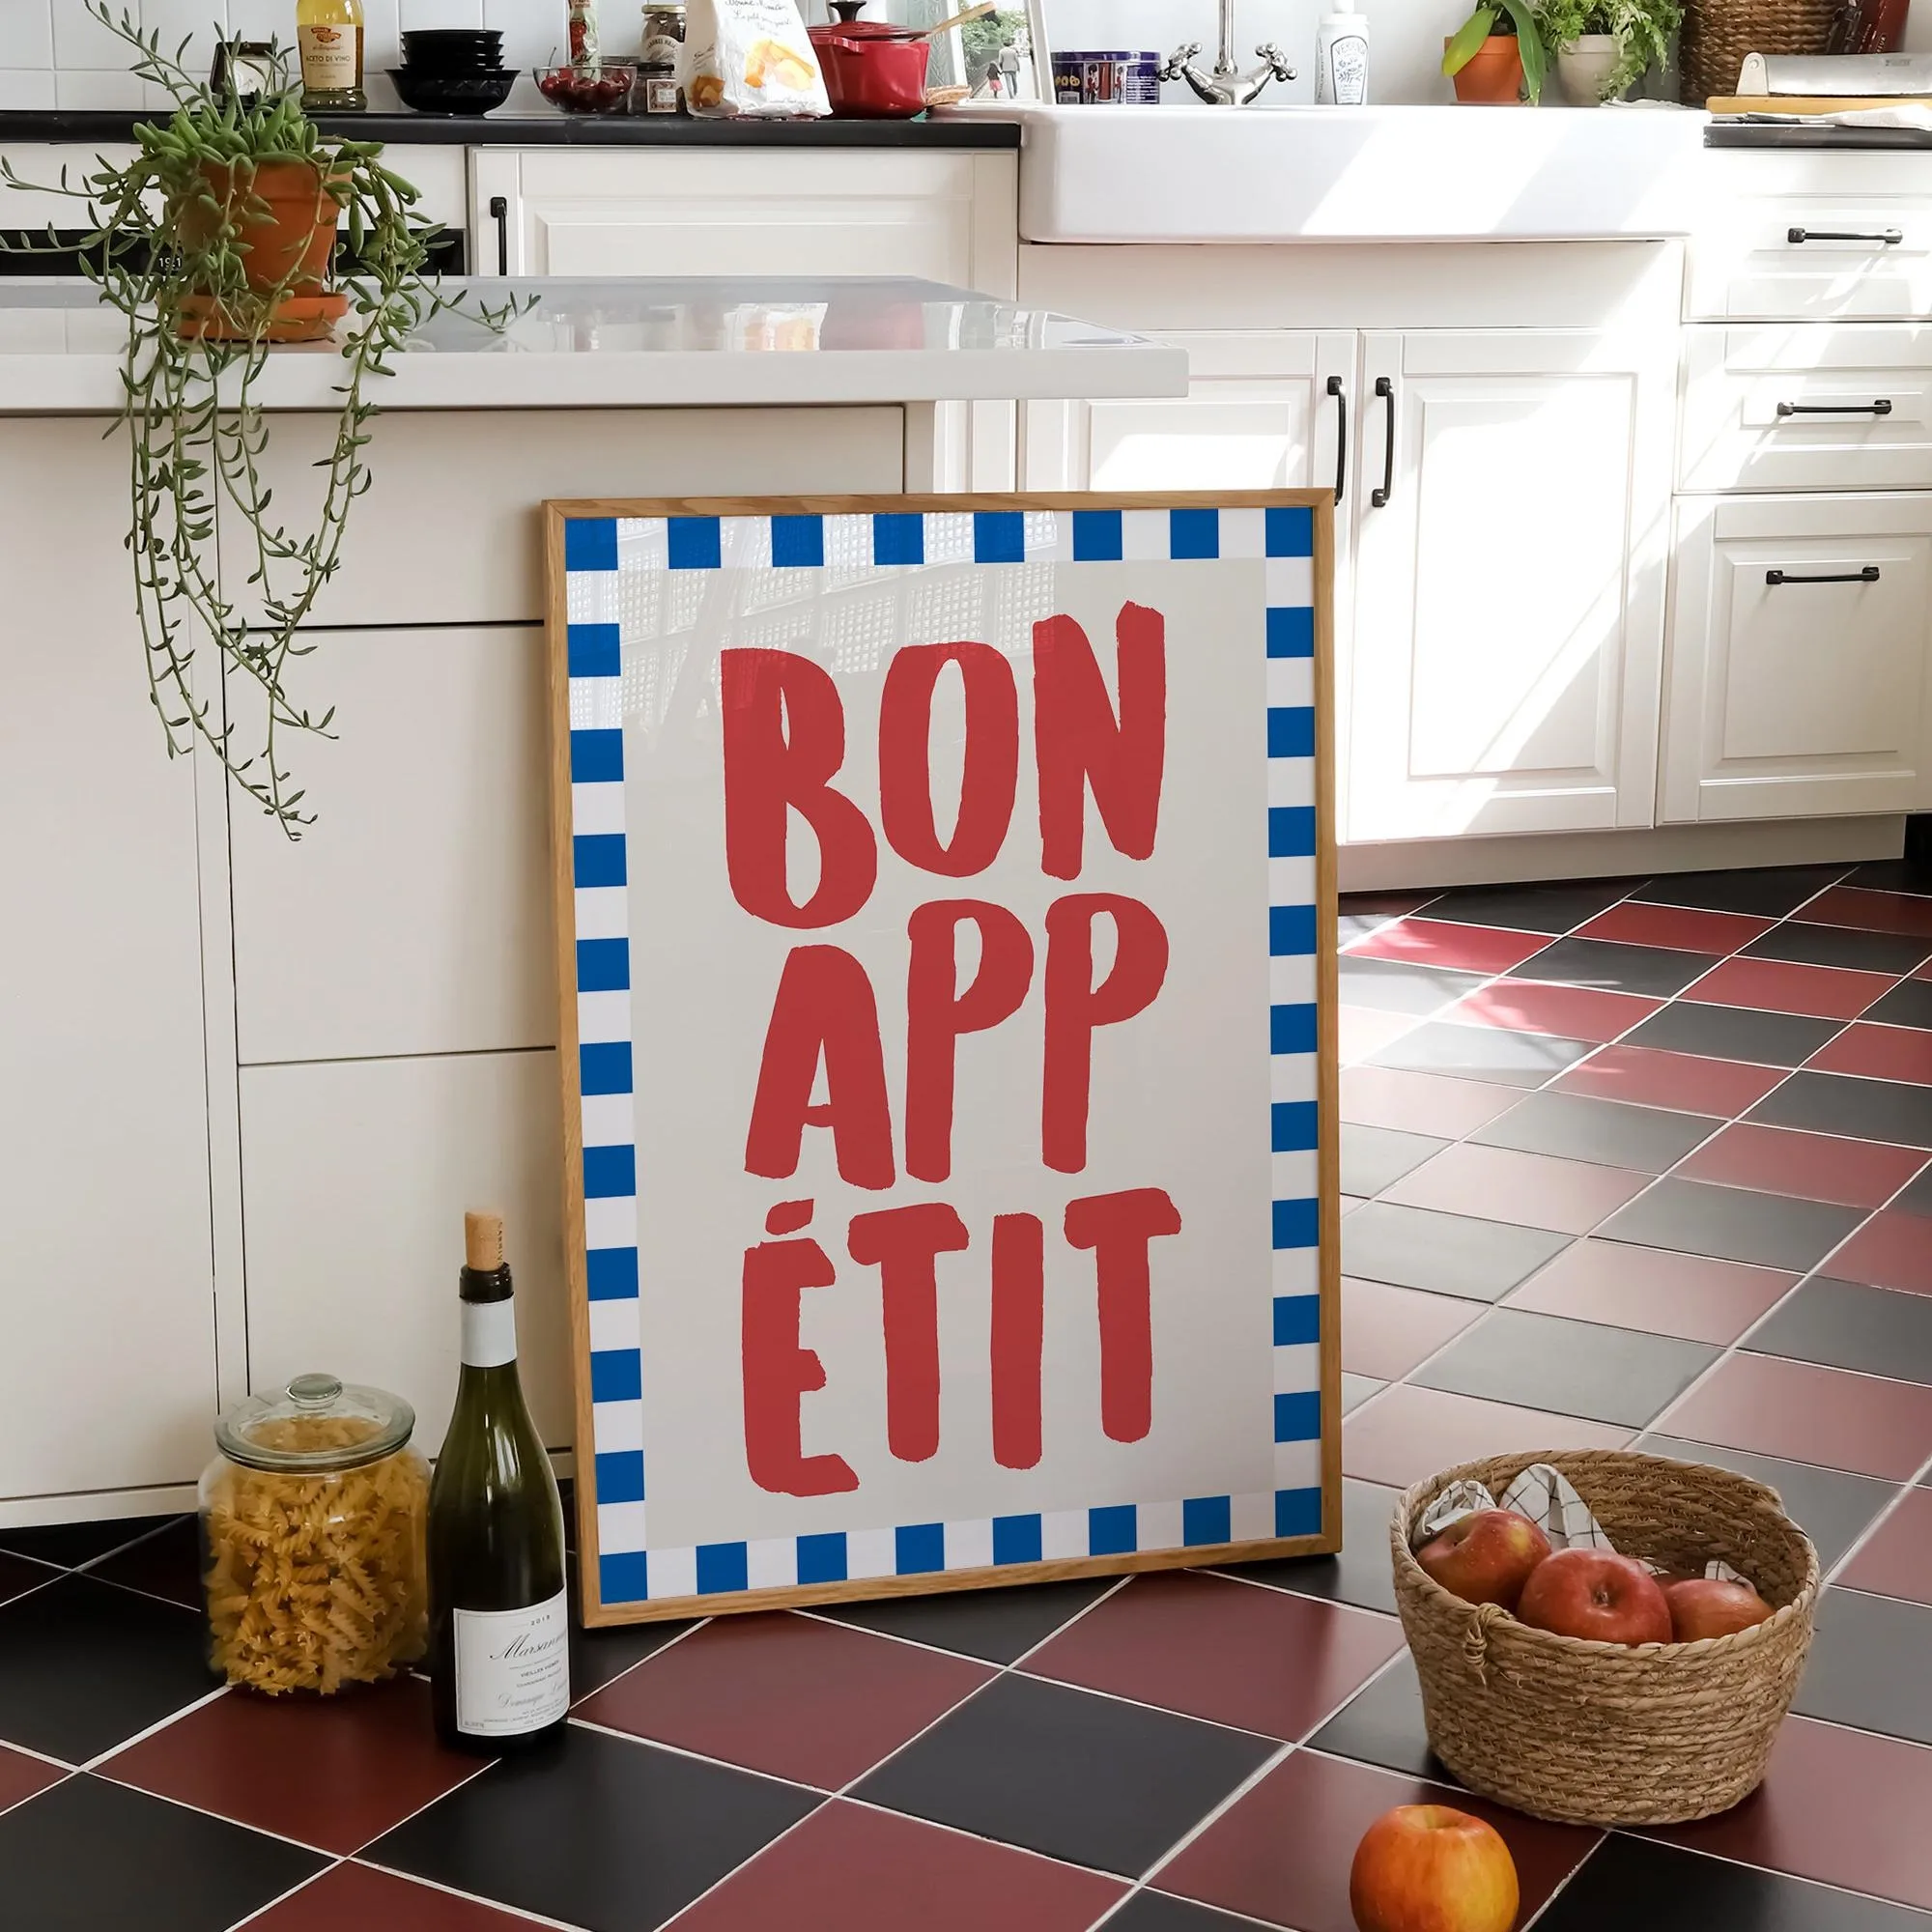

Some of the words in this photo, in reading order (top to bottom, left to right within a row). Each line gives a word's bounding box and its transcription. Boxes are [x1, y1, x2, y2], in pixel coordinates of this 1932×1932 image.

[720, 599, 1167, 930] BON
[744, 892, 1170, 1191] APP
[741, 1187, 1182, 1497] ÉTIT
